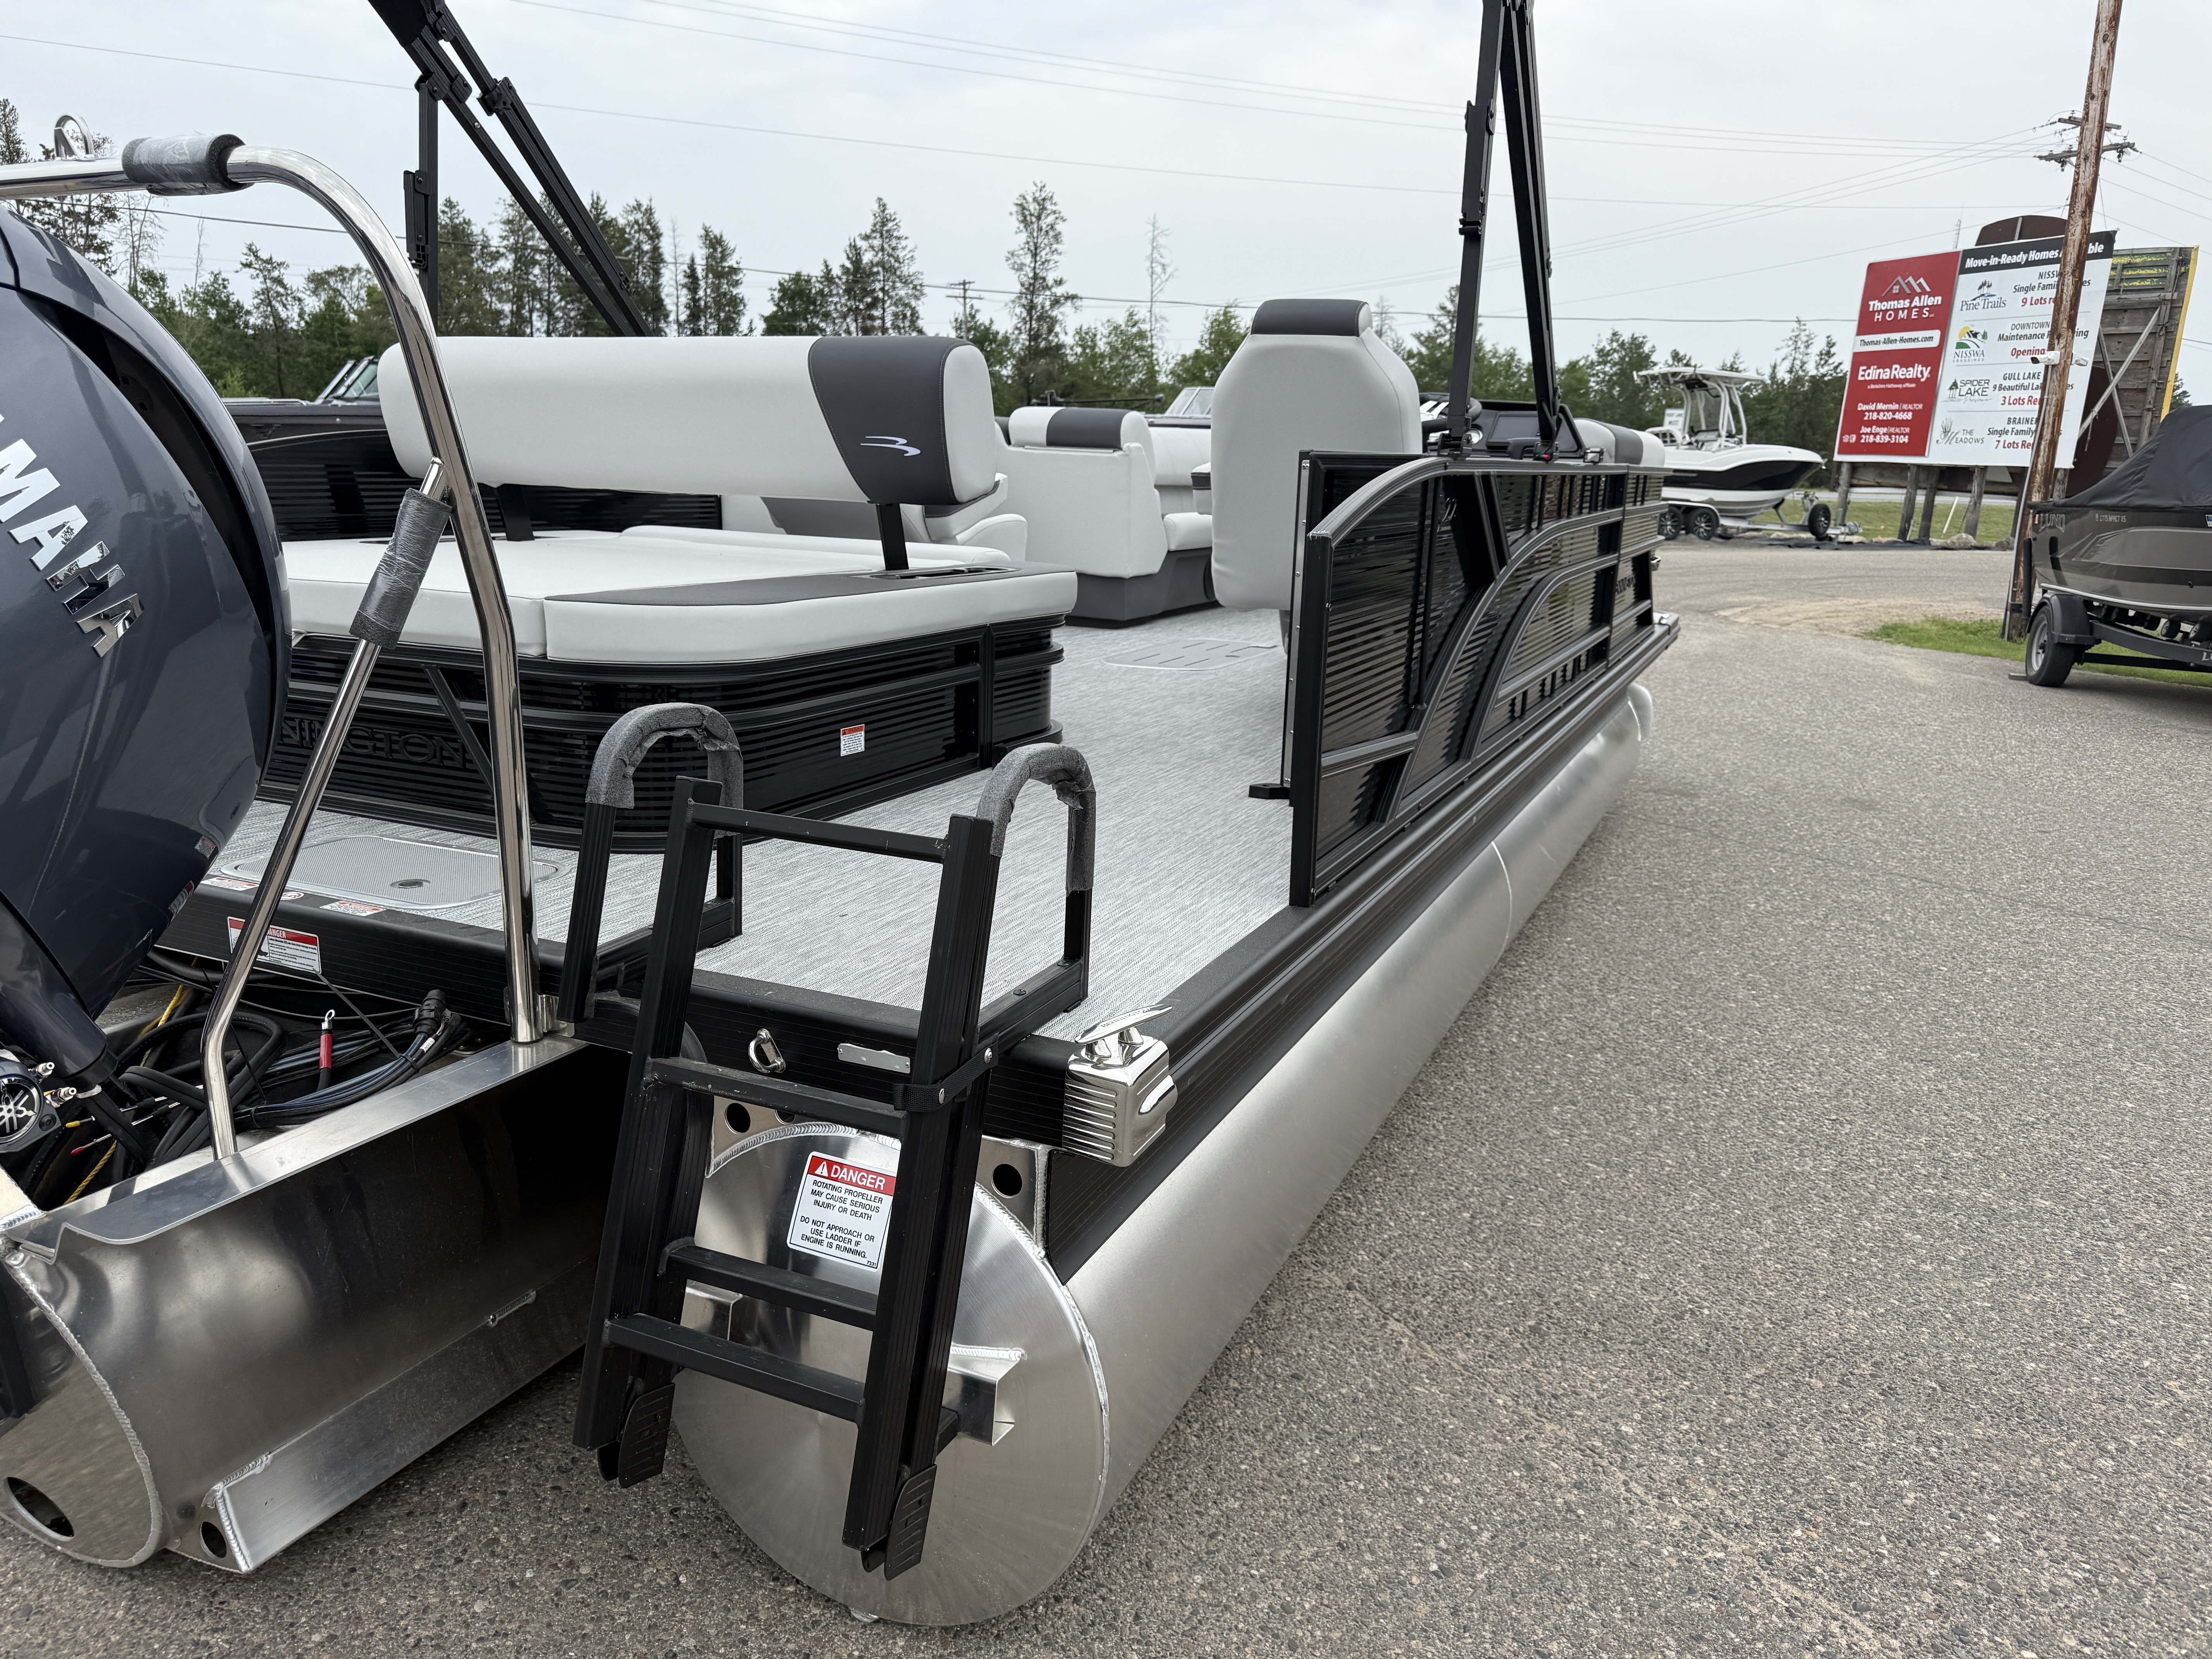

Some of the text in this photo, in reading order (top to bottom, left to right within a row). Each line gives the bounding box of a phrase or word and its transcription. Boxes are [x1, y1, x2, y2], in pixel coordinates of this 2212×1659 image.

[1965, 252, 2027, 268] Move-in-Ready
[2028, 249, 2059, 261] Homes
[2013, 283, 2036, 294] Single
[2037, 280, 2057, 291] Fami
[1869, 295, 1942, 311] Thomas Allen
[1960, 297, 2006, 311] Pine Trails
[2021, 297, 2028, 307] 9
[2030, 296, 2047, 306] Lots
[1874, 307, 1930, 322] HOMES
[2011, 321, 2051, 331] DOWNTOWN
[1860, 336, 1934, 347] Thomas-Allen-Homes.com
[1997, 330, 2045, 342] Maintenance
[1953, 349, 1985, 359] NISSWA
[2003, 371, 2042, 381] GULL LAKE
[1959, 379, 1990, 387] SPIDER
[1998, 382, 2030, 392] Beautiful
[1958, 387, 1989, 397] LAKE
[2001, 396, 2006, 405] 3
[2008, 395, 2025, 405] Lots
[1863, 412, 1913, 420] 218-820-4668
[2007, 417, 2037, 425] BRAINE
[1987, 427, 2035, 438] Single Family
[1860, 435, 1908, 443] 218-839-3104
[1995, 440, 2001, 449] 7
[2002, 440, 2019, 449] Lots
[2039, 514, 2065, 532] LUND
[831, 1165, 886, 1190] DANGER
[812, 1180, 883, 1204] ROTATING PROPELLER
[811, 1188, 880, 1213] MAY CAUSE SERIOUS
[813, 1199, 872, 1221] INJURY OR DEATH
[800, 1216, 875, 1243] DO NOT APPROACH OR
[811, 1228, 823, 1237] USE
[826, 1232, 853, 1245] LADDER
[801, 1234, 824, 1247] ENGINE
[835, 1244, 867, 1259] RUNNING.
